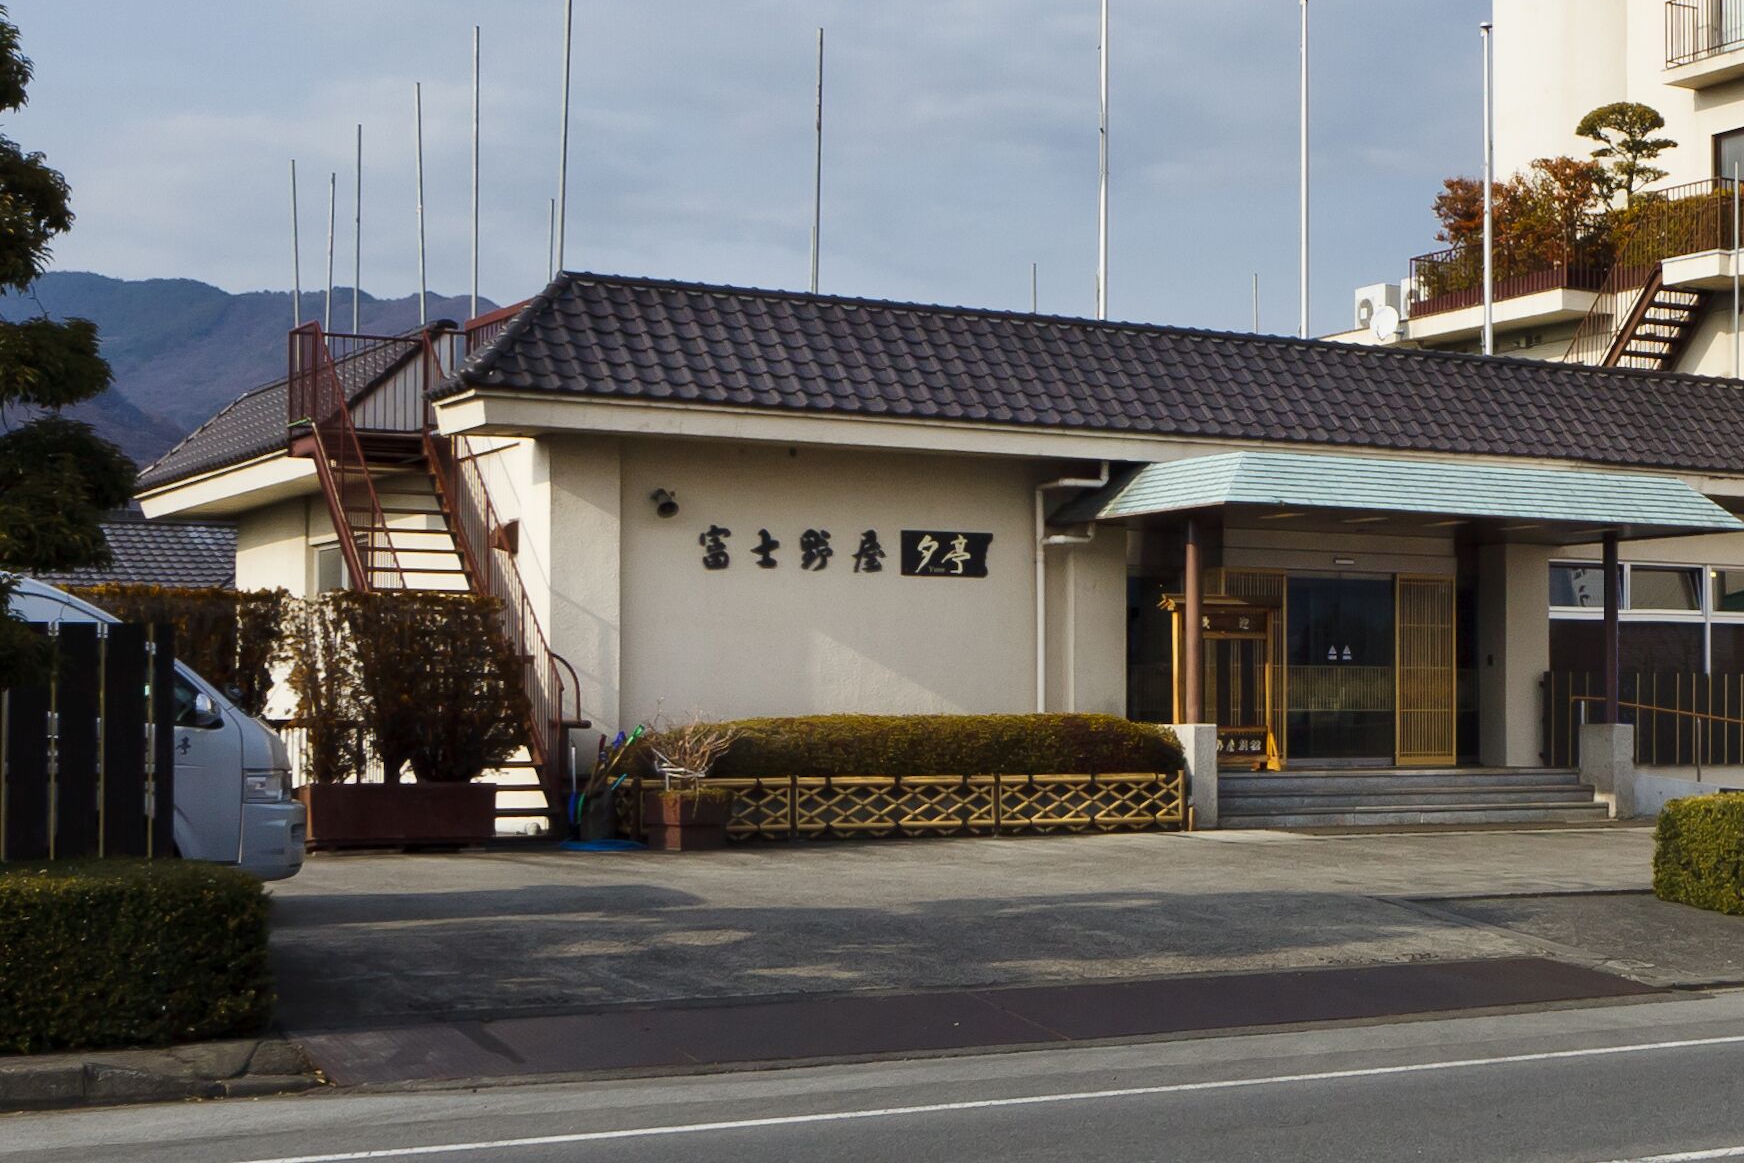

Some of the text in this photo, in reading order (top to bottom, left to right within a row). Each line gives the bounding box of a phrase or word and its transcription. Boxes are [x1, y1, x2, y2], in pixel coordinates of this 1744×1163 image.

[699, 525, 887, 574] 富士野屋
[915, 534, 971, 574] 夕亭
